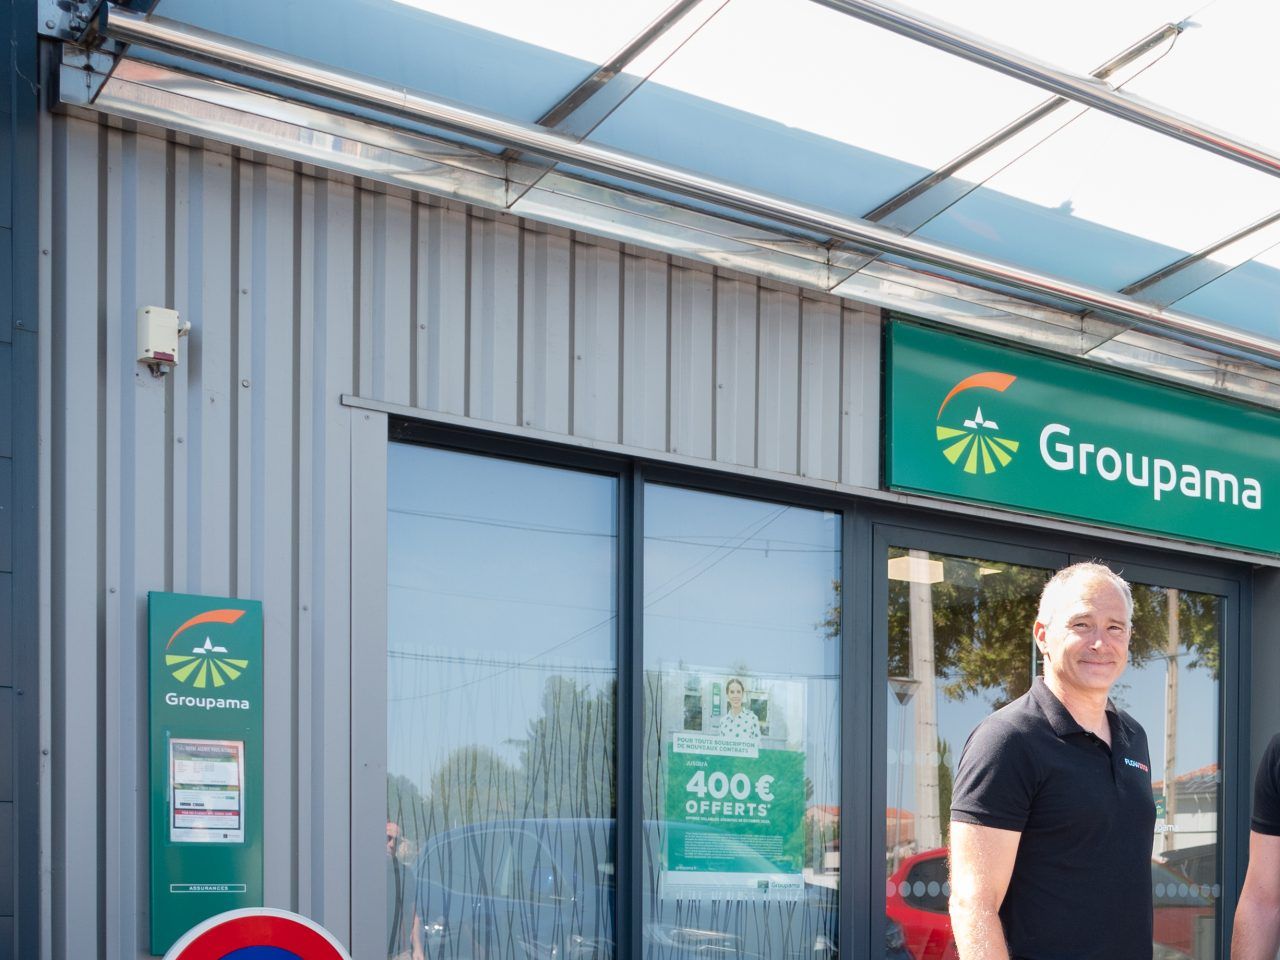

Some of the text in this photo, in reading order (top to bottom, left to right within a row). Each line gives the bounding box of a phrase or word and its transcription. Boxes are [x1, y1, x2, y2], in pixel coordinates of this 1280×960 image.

[1039, 423, 1262, 510] Groupama
[165, 692, 250, 710] Groupama
[686, 743, 718, 751] NOUVEAUX
[714, 740, 755, 748] SOUSCRIPTION
[686, 770, 775, 801] 400 €
